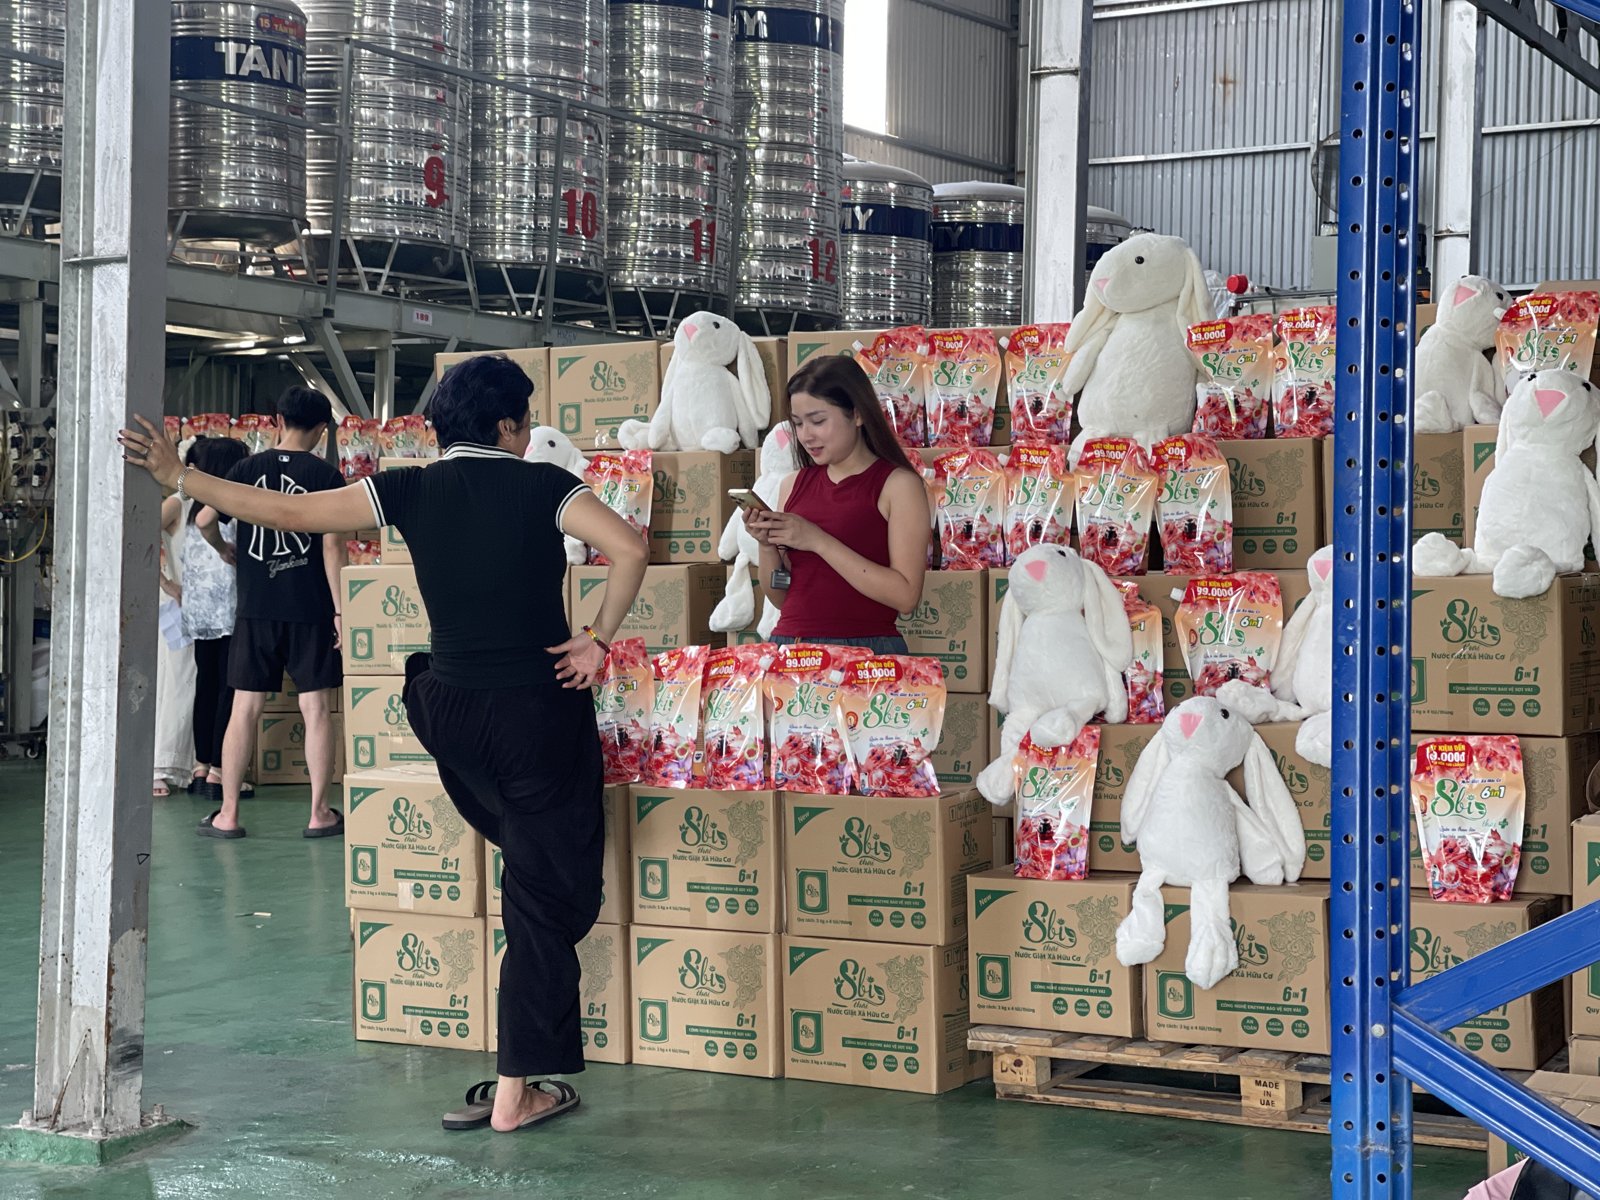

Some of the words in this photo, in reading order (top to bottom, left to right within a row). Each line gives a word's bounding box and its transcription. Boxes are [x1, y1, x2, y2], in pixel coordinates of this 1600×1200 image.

[259, 17, 272, 29] 15
[423, 156, 448, 208] 9
[562, 188, 598, 239] 10
[689, 217, 717, 264] 11
[807, 238, 838, 285] 12
[1236, 352, 1257, 365] 6in1
[1288, 341, 1324, 373] Sbi
[894, 362, 913, 373] 6in1
[969, 364, 988, 374] 6in1
[589, 360, 626, 393] Sbi
[1477, 447, 1490, 459] New
[1226, 457, 1265, 497] Sbi
[623, 483, 640, 493] 6in1
[653, 470, 687, 504] Sbi
[1276, 511, 1297, 525] 6IN1
[1196, 586, 1234, 598] 99.000đ
[381, 585, 420, 619] Sbi
[1240, 616, 1263, 628] 6in1
[1439, 598, 1501, 647] Sbi
[1431, 652, 1451, 660] Nước
[1451, 652, 1467, 661] Giặt
[1467, 652, 1477, 660] Xả
[1478, 652, 1494, 661] Hữu
[1495, 652, 1506, 661] Cơ
[786, 658, 822, 669] 99.000đ
[857, 668, 896, 679] 99.000đ
[1514, 666, 1540, 682] 6IN1
[617, 680, 638, 693] 6in1
[786, 682, 831, 720] Sbi
[906, 697, 929, 710] 6in1
[863, 692, 911, 729] Sbi
[1453, 743, 1466, 751] ĐẾN
[1103, 793, 1118, 801] Hữu
[1480, 785, 1506, 799] 6in1
[1304, 800, 1314, 808] Cơ
[1430, 778, 1487, 821] Sbi
[388, 797, 433, 840] Sbi
[797, 811, 811, 824] New
[678, 806, 728, 850] Sbi
[839, 816, 892, 862] Sbi
[416, 843, 428, 851] Hữu
[428, 844, 436, 852] Cơ
[710, 855, 723, 863] Hữu
[723, 855, 732, 863] Cơ
[832, 865, 849, 873] Nước
[849, 866, 863, 875] Giặt
[863, 867, 872, 875] Xả
[872, 867, 886, 875] Hữu
[886, 868, 896, 876] Cơ
[978, 893, 993, 907] New
[1022, 900, 1077, 949] Sbi
[640, 942, 653, 953] New
[397, 933, 441, 976] Sbi
[792, 951, 806, 964] New
[1014, 950, 1032, 960] Nước
[1032, 952, 1046, 962] Giặt
[1047, 952, 1056, 961] Xả
[1057, 953, 1071, 962] Hữu
[1071, 954, 1081, 962] Cơ
[678, 948, 727, 994] Sbi
[1088, 968, 1111, 985] 6IN1
[1235, 970, 1245, 979] Xả
[1246, 970, 1262, 980] Hữu
[1262, 971, 1274, 980] Cơ
[833, 958, 886, 1006] Sbi
[1282, 985, 1308, 1003] 6IN1
[671, 996, 687, 1004] Nước
[687, 997, 700, 1006] Giặt
[700, 997, 708, 1005] Xả
[708, 998, 721, 1006] Hữu
[721, 998, 730, 1008] Cơ
[826, 1007, 843, 1016] Nước
[843, 1009, 857, 1018] Giặt
[858, 1009, 866, 1017] Xả
[866, 1009, 880, 1019] Hữu
[880, 1010, 890, 1019] Cơ
[1586, 1006, 1600, 1014] Quy
[1254, 1079, 1279, 1090] MADE
[1263, 1090, 1271, 1098] IN
[1259, 1098, 1275, 1108] UAE
